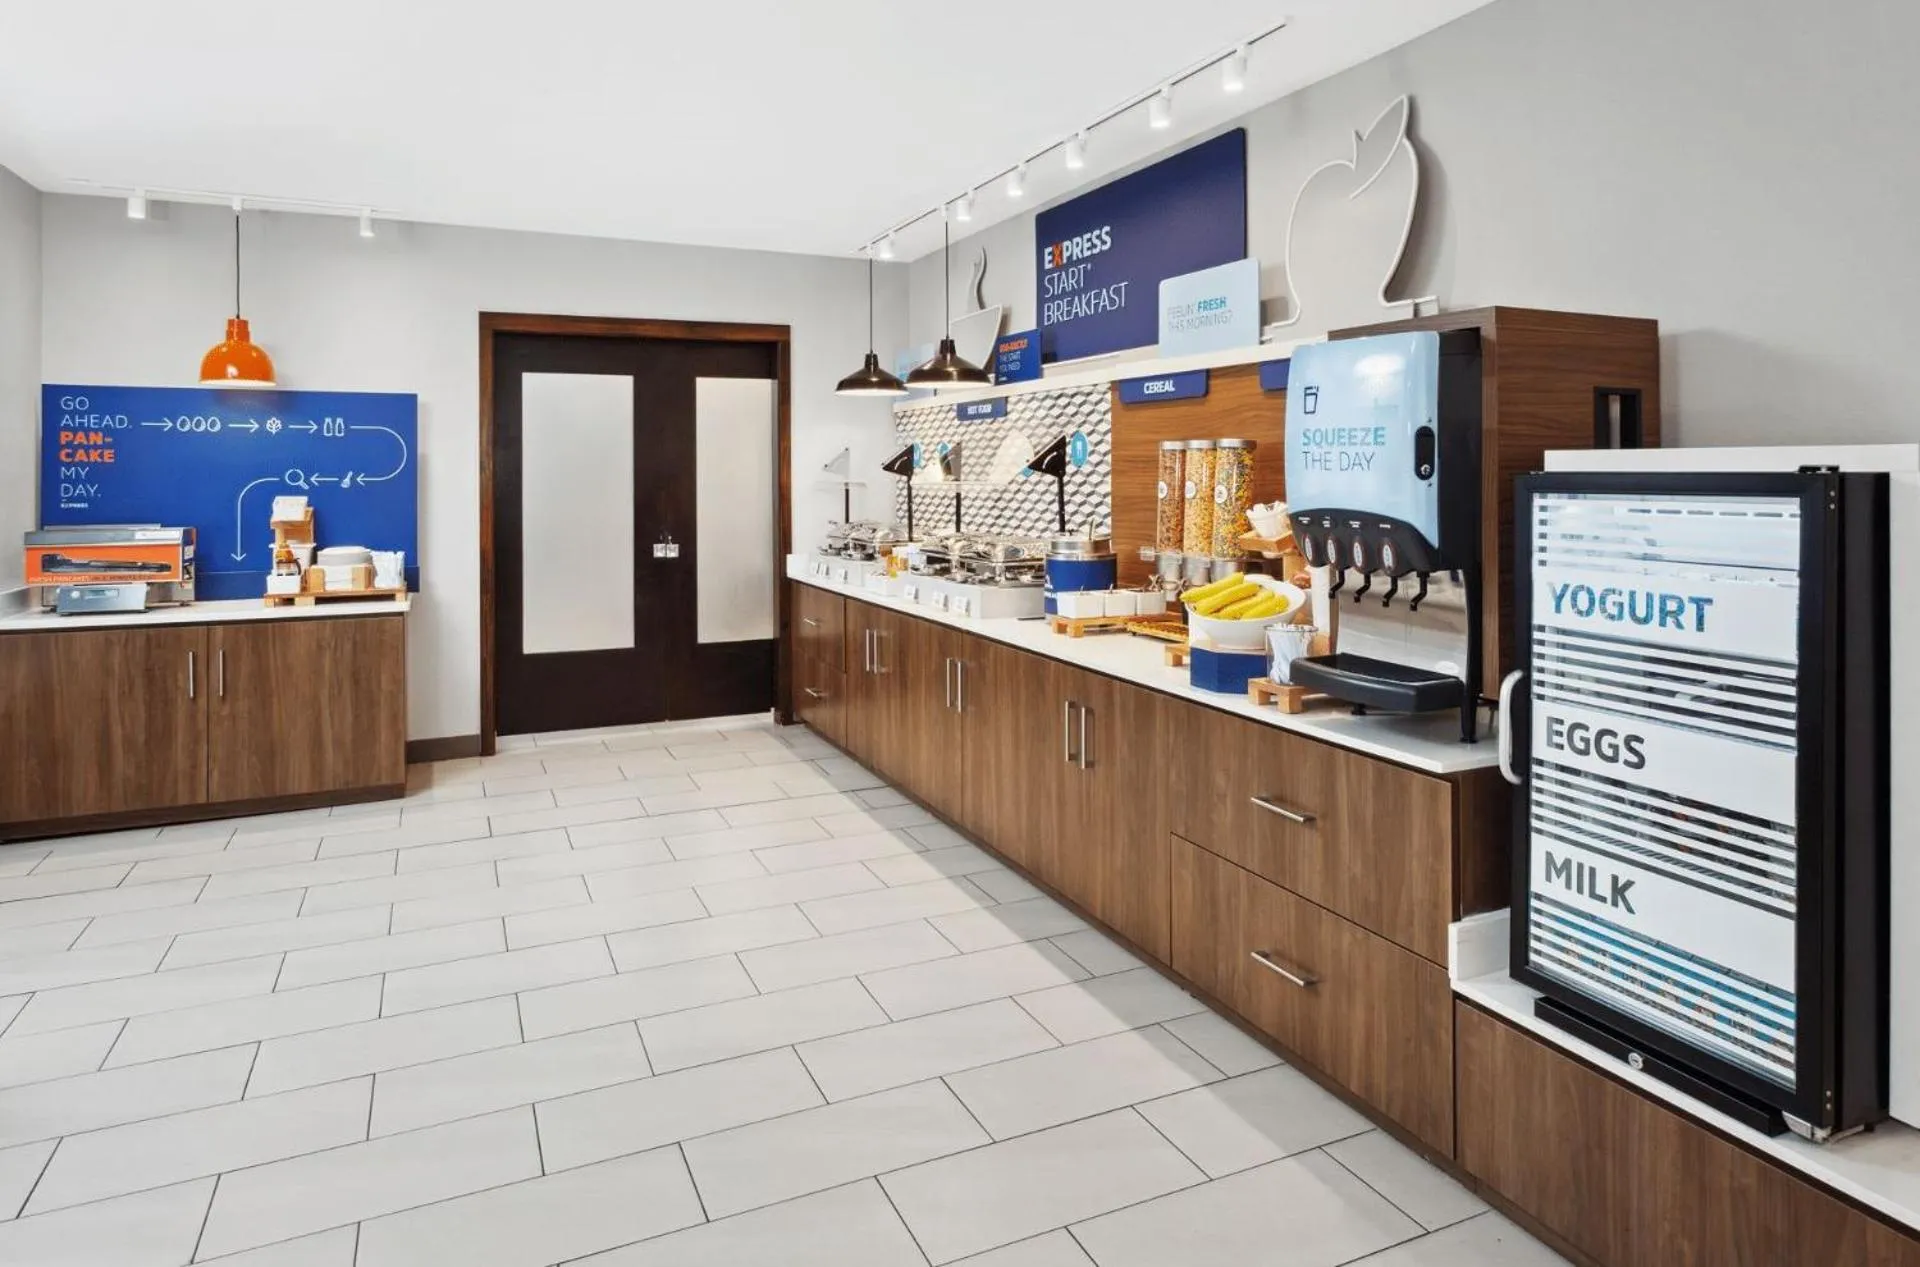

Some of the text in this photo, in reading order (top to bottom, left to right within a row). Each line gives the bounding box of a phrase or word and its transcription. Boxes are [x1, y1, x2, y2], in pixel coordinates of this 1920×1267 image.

[1043, 225, 1112, 270] EXPRESS
[1043, 281, 1129, 326] BREAKFAST
[1197, 297, 1227, 313] FRESH
[1143, 380, 1175, 394] CEREAL
[60, 396, 89, 411] GO
[60, 414, 133, 429] AHEAD.
[59, 431, 113, 445] PAN-
[1302, 427, 1386, 447] SQUEEZE
[59, 448, 115, 463] CAKE
[1302, 451, 1376, 471] THE DAY
[60, 466, 89, 479] MY
[60, 483, 101, 498] DAY.
[1549, 583, 1713, 632] YOGURT
[1546, 716, 1645, 770] EGGS
[1545, 850, 1636, 915] MILK
